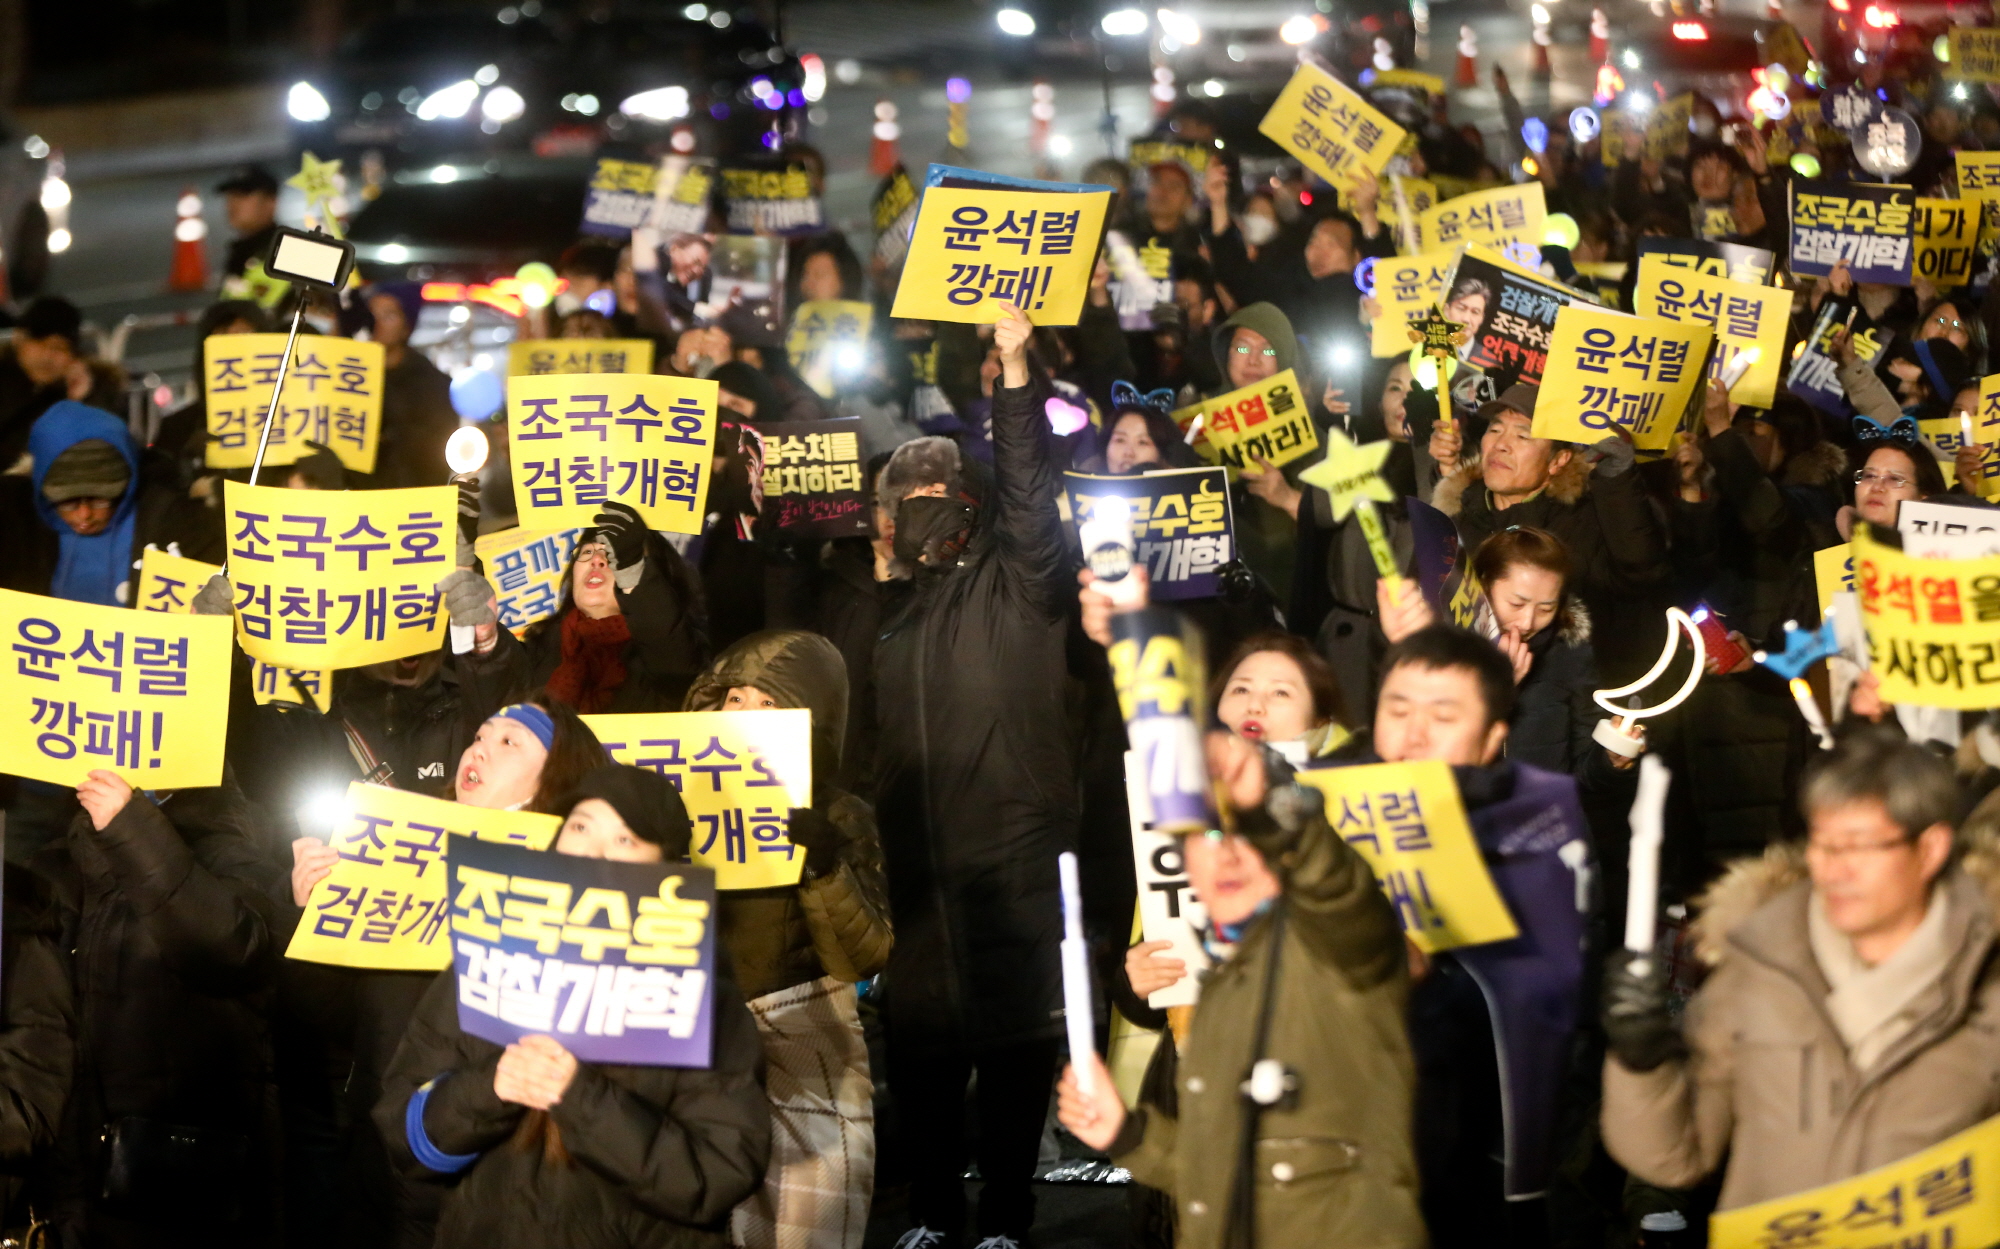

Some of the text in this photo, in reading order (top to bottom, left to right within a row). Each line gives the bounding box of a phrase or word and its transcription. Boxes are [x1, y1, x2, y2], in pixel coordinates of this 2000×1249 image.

[1302, 85, 1383, 153] 윤석렬
[1292, 118, 1355, 177] 깡패!
[943, 206, 1080, 255] 윤석렬
[1436, 197, 1527, 242] 윤석렬
[1794, 192, 1912, 236] 조국수호
[1793, 227, 1910, 271] 검찰개혁
[946, 264, 1053, 310] 깡패!
[1500, 285, 1558, 326] 검찰개
[1655, 279, 1763, 339] 윤석렬
[212, 354, 370, 395] 조국수호
[1576, 328, 1690, 383] 윤석렬
[216, 405, 366, 451] 검찰개혁
[517, 394, 706, 446] 조국수호
[1578, 385, 1665, 435] 깡패!
[763, 432, 858, 465] 공수처를
[522, 456, 700, 512] 검찰개혁
[763, 463, 863, 496] 설치하라
[232, 511, 446, 571] 조국수호
[234, 581, 441, 644] 검찰개혁
[12, 617, 188, 696] 윤석렬
[29, 697, 162, 769] 깡패!
[682, 807, 796, 864] 개혁
[451, 865, 710, 967] 조국수호
[456, 938, 709, 1040] 검찰개혁
[1755, 1155, 1974, 1249] 윤석렬
